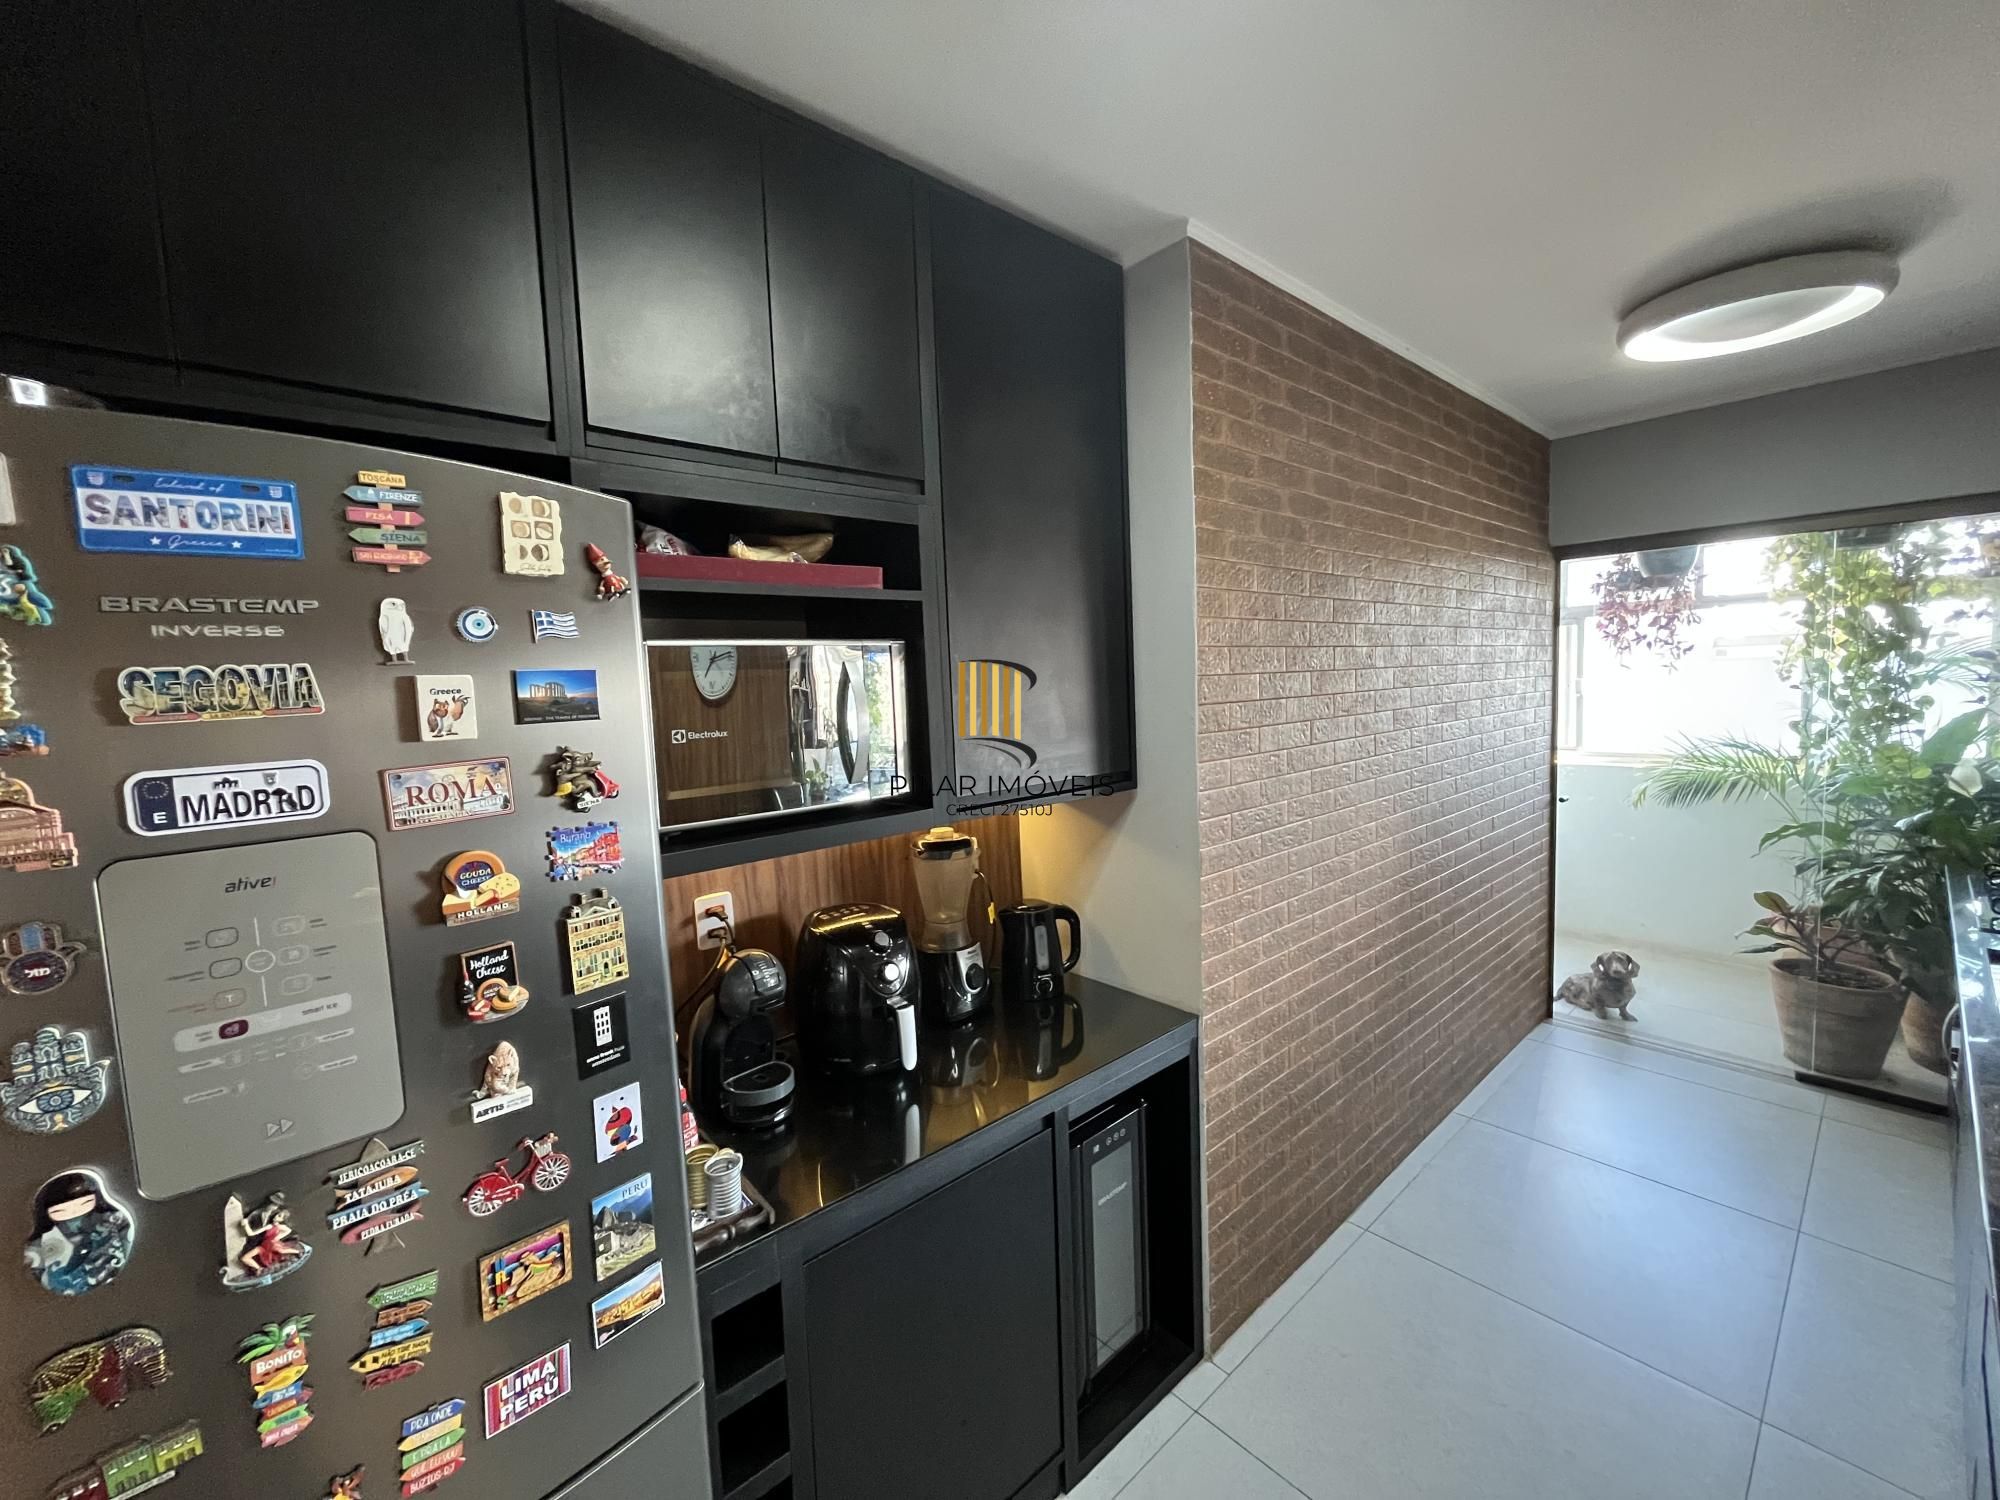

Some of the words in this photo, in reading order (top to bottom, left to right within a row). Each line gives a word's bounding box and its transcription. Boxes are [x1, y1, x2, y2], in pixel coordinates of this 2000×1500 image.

[361, 473, 404, 485] TOSCANA
[379, 491, 418, 502] FIRENZE
[85, 493, 291, 535] SANTORINI
[365, 512, 393, 520] PISA
[381, 533, 421, 542] SIENA
[100, 597, 319, 614] BRASTEMP
[151, 624, 284, 637] INVERSE
[117, 663, 325, 718] SEGOVIA
[430, 688, 462, 696] Greece
[688, 729, 728, 740] Electrolux
[405, 776, 497, 807] ROMA
[153, 811, 167, 824] E
[460, 868, 491, 880] GOUDA
[457, 902, 509, 920] HOLLAND
[470, 950, 509, 971] Holland
[476, 965, 506, 980] Cheese
[476, 1103, 505, 1119] ARTIS
[337, 1148, 416, 1185] JERICOACOARA-CE
[344, 1174, 402, 1204] TATAJUBA
[621, 1178, 649, 1198] PERU
[332, 1211, 370, 1230] PRAIA
[371, 1201, 387, 1214] DO
[256, 1349, 301, 1375] BONITO
[501, 1361, 556, 1398] LIMA
[500, 1375, 559, 1422] PERÚ
[410, 1415, 429, 1433] PRA
[431, 1405, 454, 1423] ONDE
